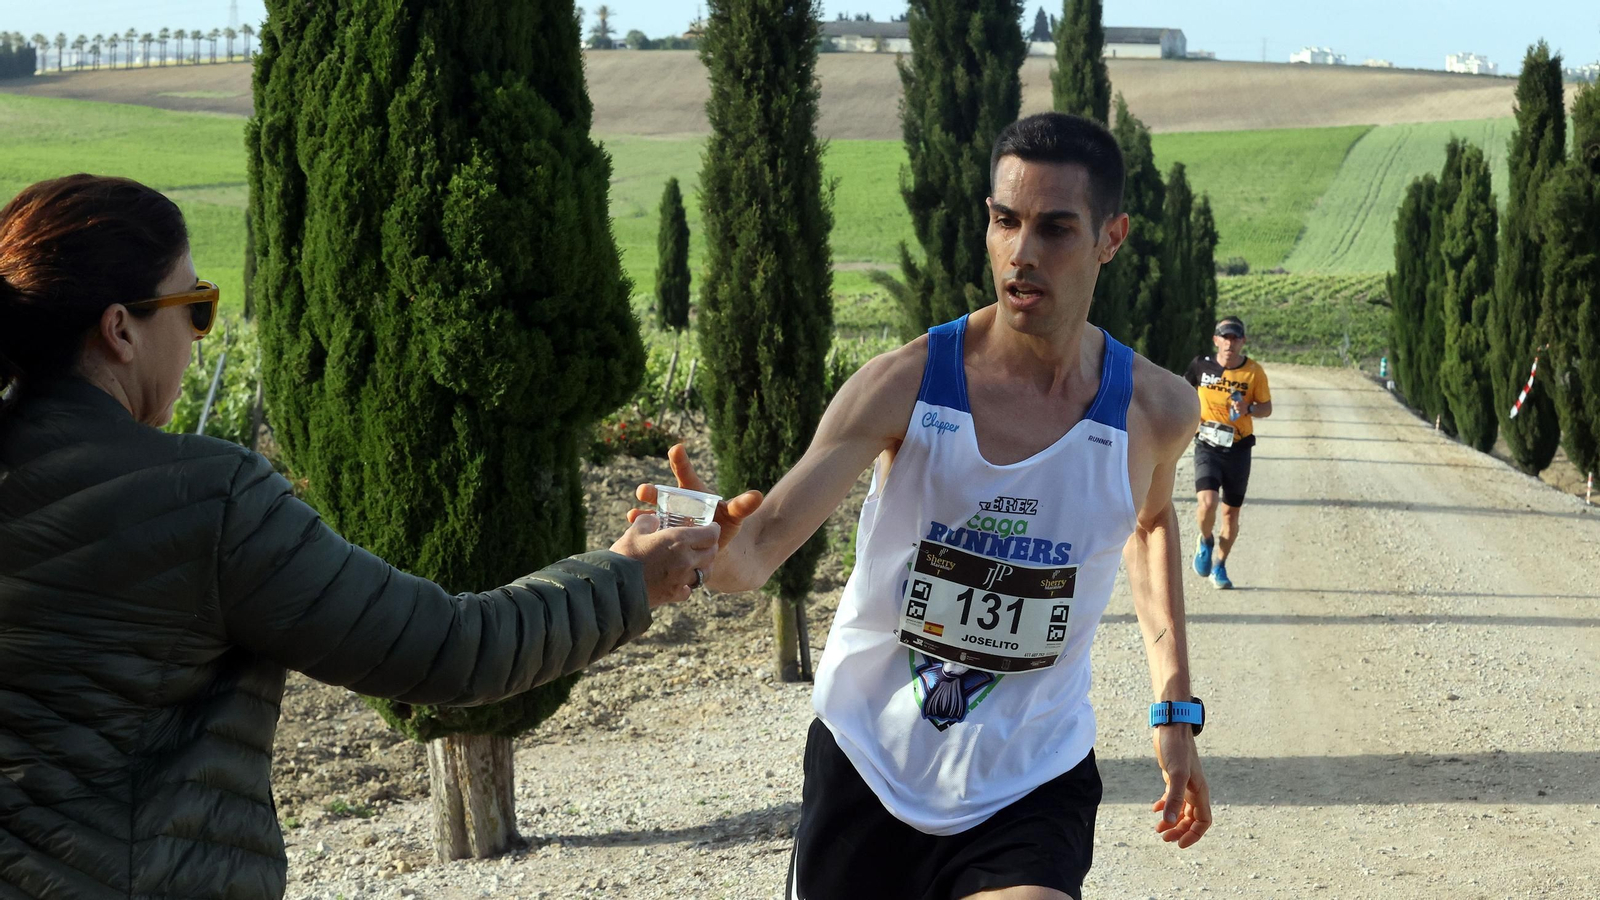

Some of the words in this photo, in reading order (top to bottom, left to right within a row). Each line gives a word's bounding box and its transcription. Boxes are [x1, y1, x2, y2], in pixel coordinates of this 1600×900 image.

[1201, 372, 1248, 390] bichos
[921, 411, 960, 435] Clapper
[1087, 435, 1113, 447] RUNNEK
[979, 496, 1038, 515] EREZ
[966, 514, 1028, 538] caga
[926, 521, 1072, 565] RUNNERS
[926, 553, 956, 570] sherry
[1040, 579, 1067, 588] sherry
[956, 587, 1025, 635] 131
[961, 634, 1019, 651] JOSELITO
